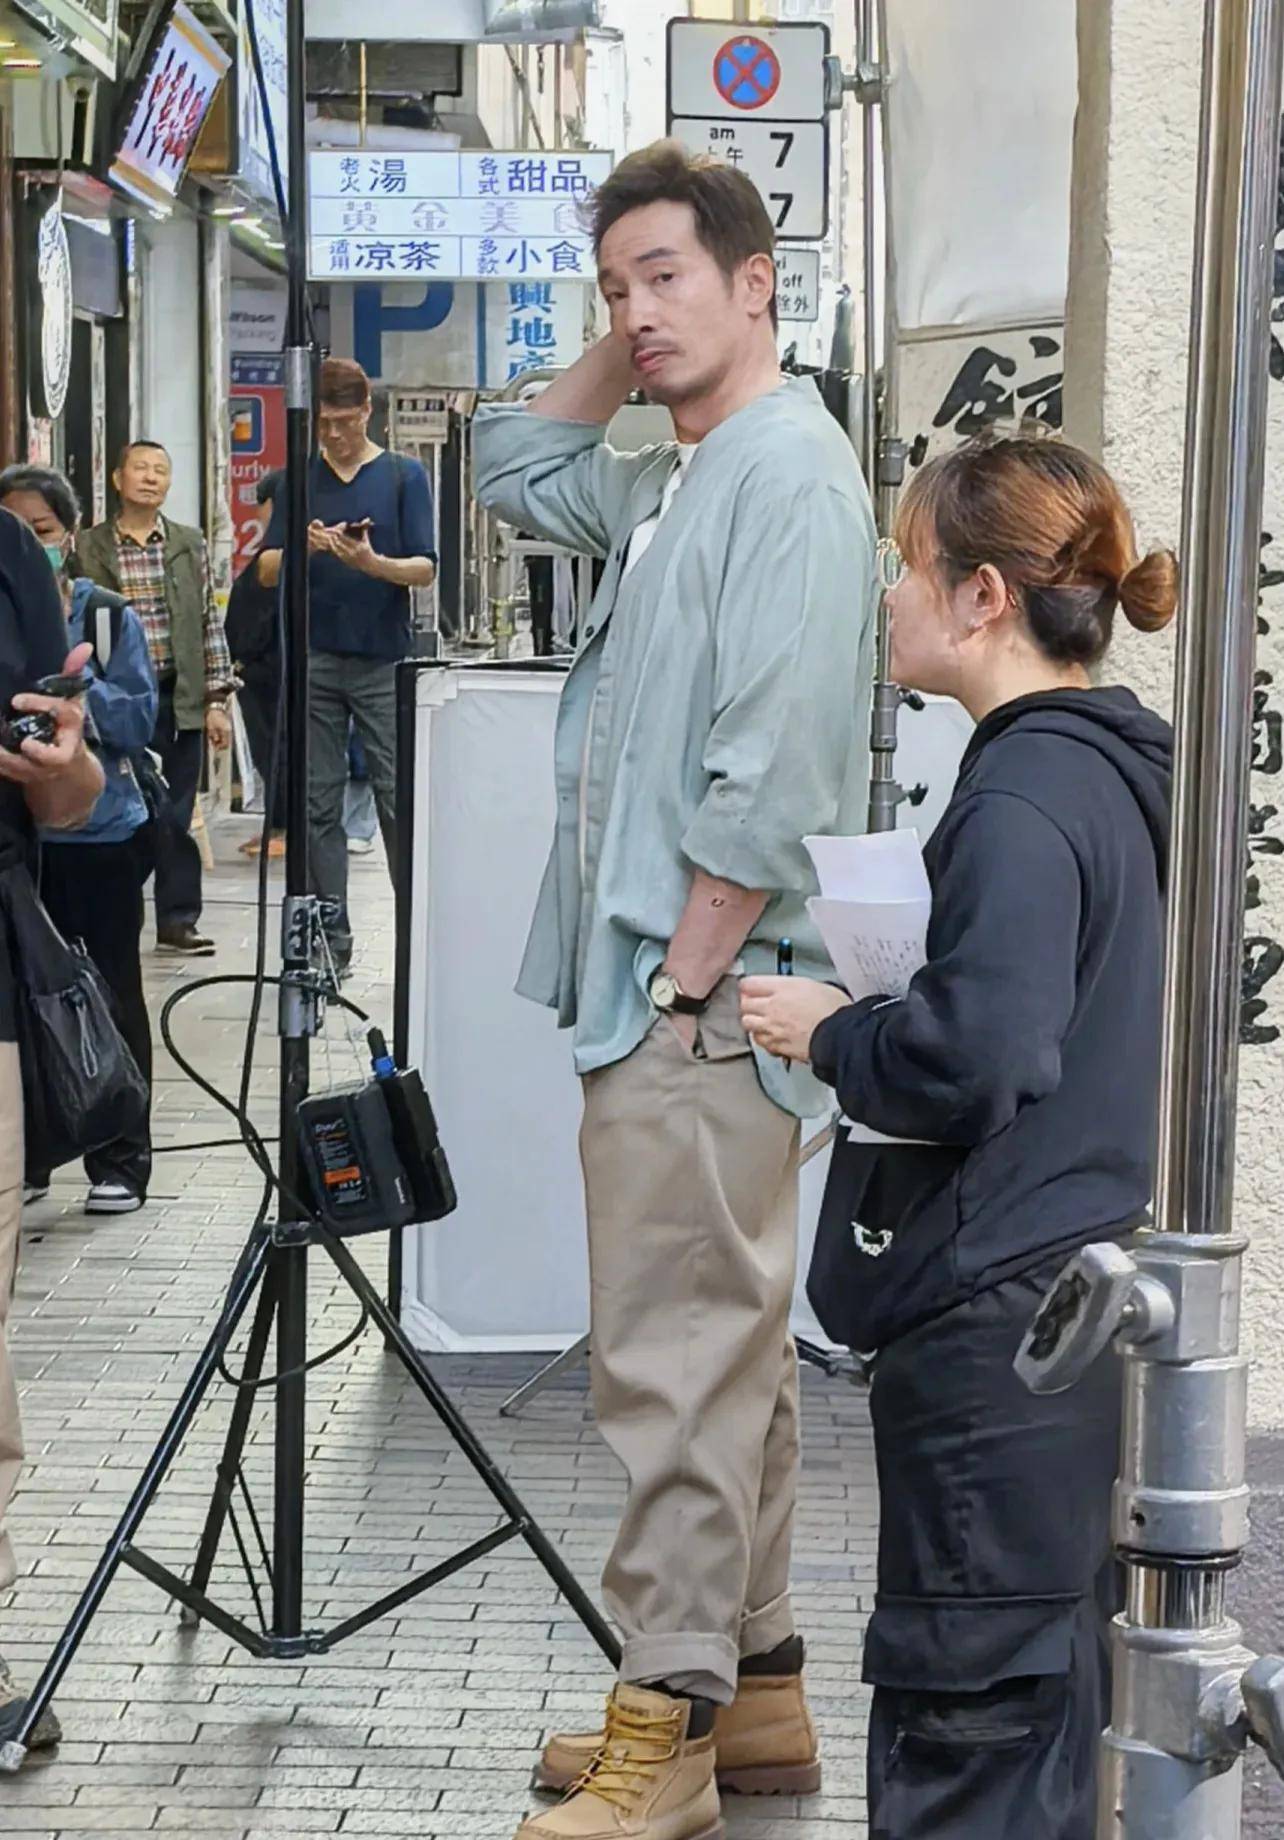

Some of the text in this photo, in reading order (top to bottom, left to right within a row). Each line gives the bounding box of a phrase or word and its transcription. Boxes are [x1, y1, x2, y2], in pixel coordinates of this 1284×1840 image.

[709, 127, 735, 139] am
[769, 132, 794, 168] 7
[369, 158, 407, 194] 湯
[507, 159, 587, 193] 甜品
[769, 193, 793, 228] 7
[506, 240, 584, 273] 小食
[782, 273, 803, 288] off
[354, 281, 454, 378] P
[231, 460, 271, 480] urly
